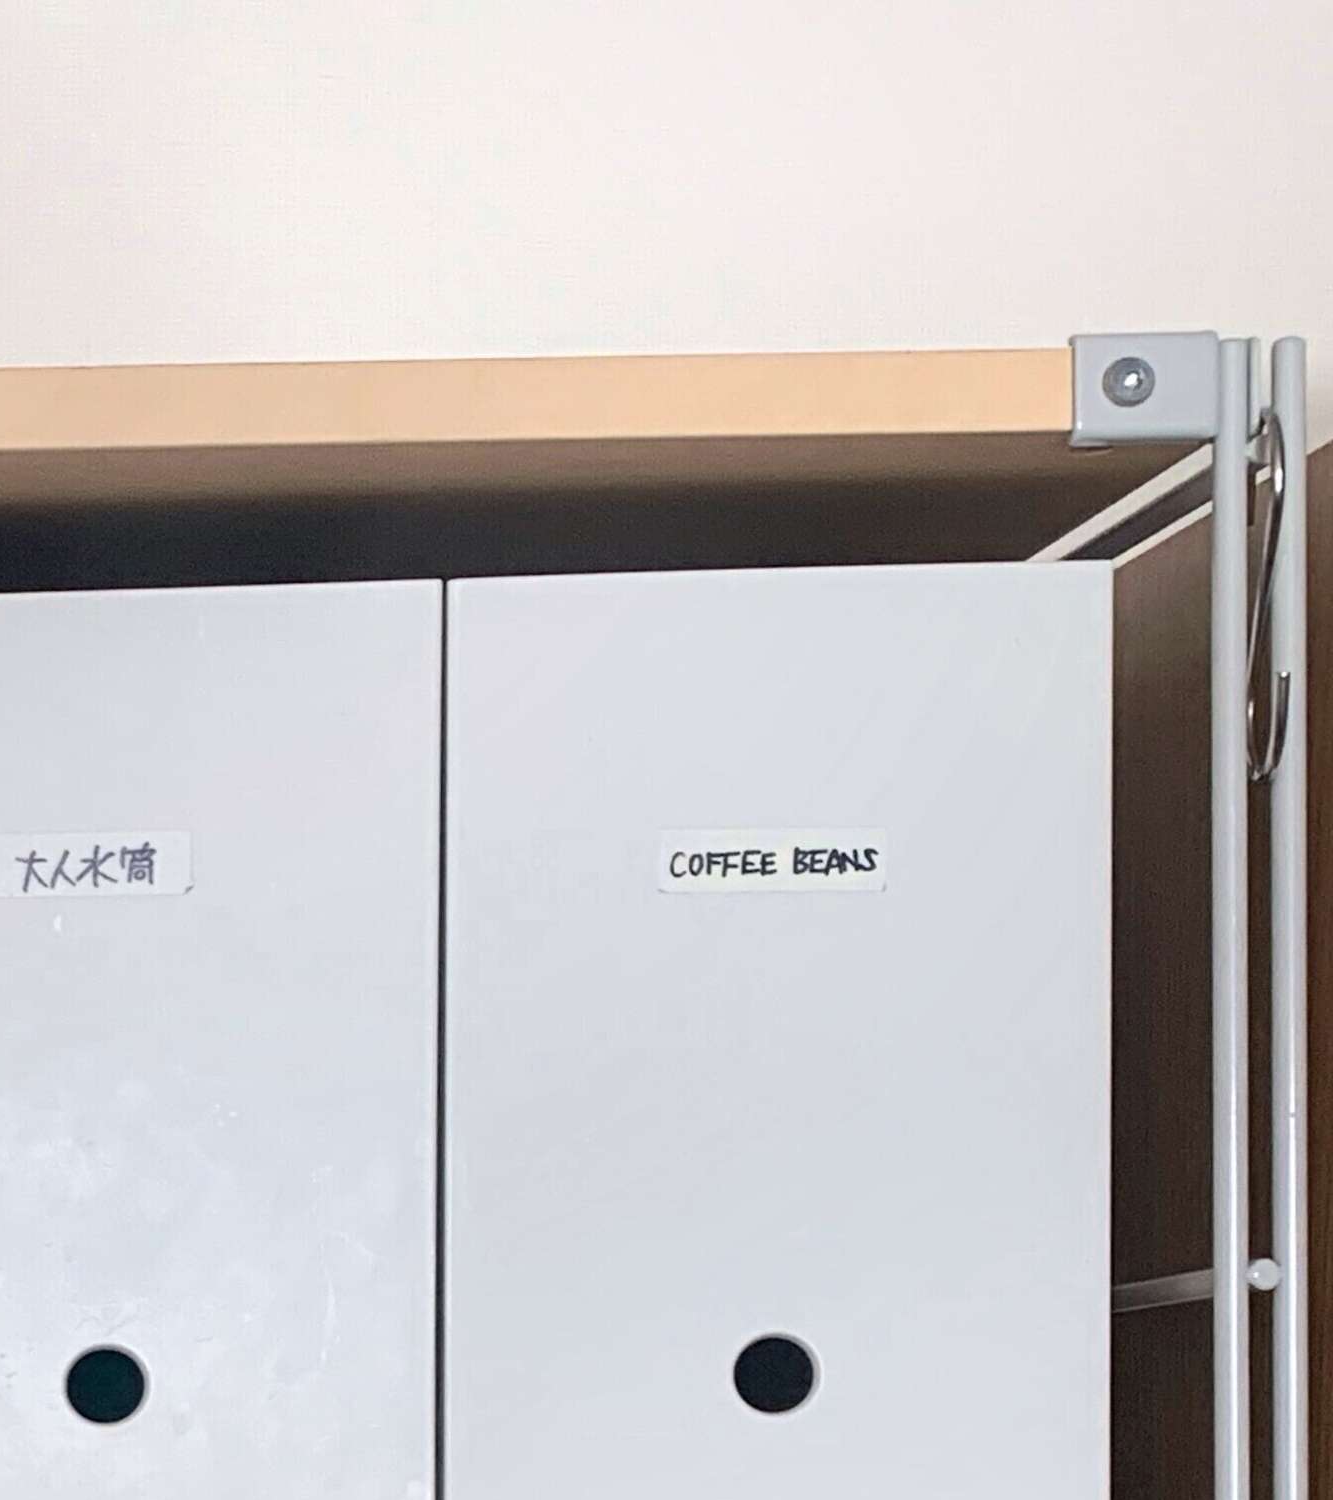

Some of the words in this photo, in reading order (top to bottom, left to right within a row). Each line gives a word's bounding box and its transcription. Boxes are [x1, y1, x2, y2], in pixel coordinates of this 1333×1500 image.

[14, 841, 157, 893] 大人水筒
[669, 850, 777, 878] COFFEE
[792, 846, 879, 876] BEANS
